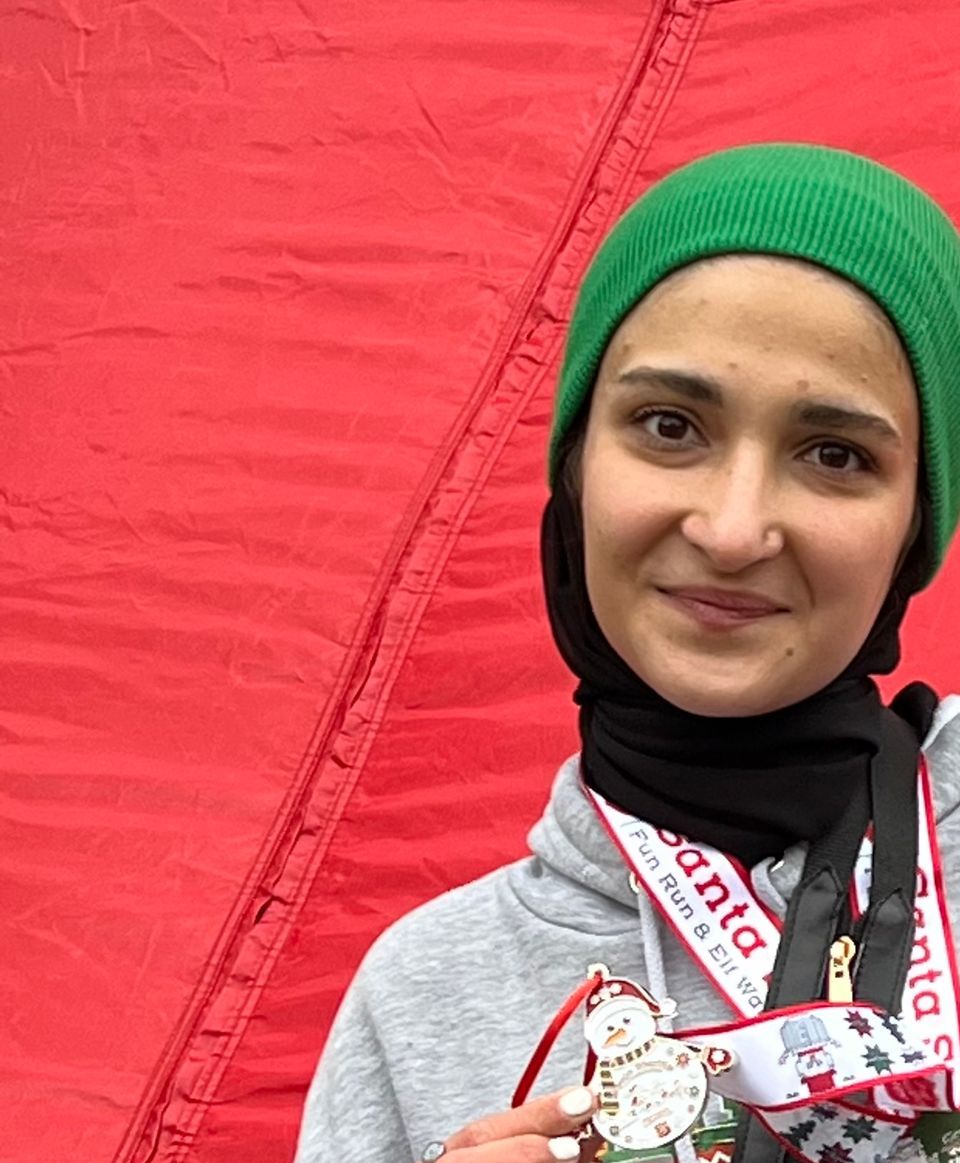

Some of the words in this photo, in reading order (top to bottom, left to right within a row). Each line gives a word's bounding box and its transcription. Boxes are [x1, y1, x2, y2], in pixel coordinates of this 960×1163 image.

[629, 829, 661, 871] Fun
[659, 873, 695, 920] Run
[694, 922, 711, 940] &
[707, 943, 739, 976] Elf
[736, 976, 764, 1009] Wa
